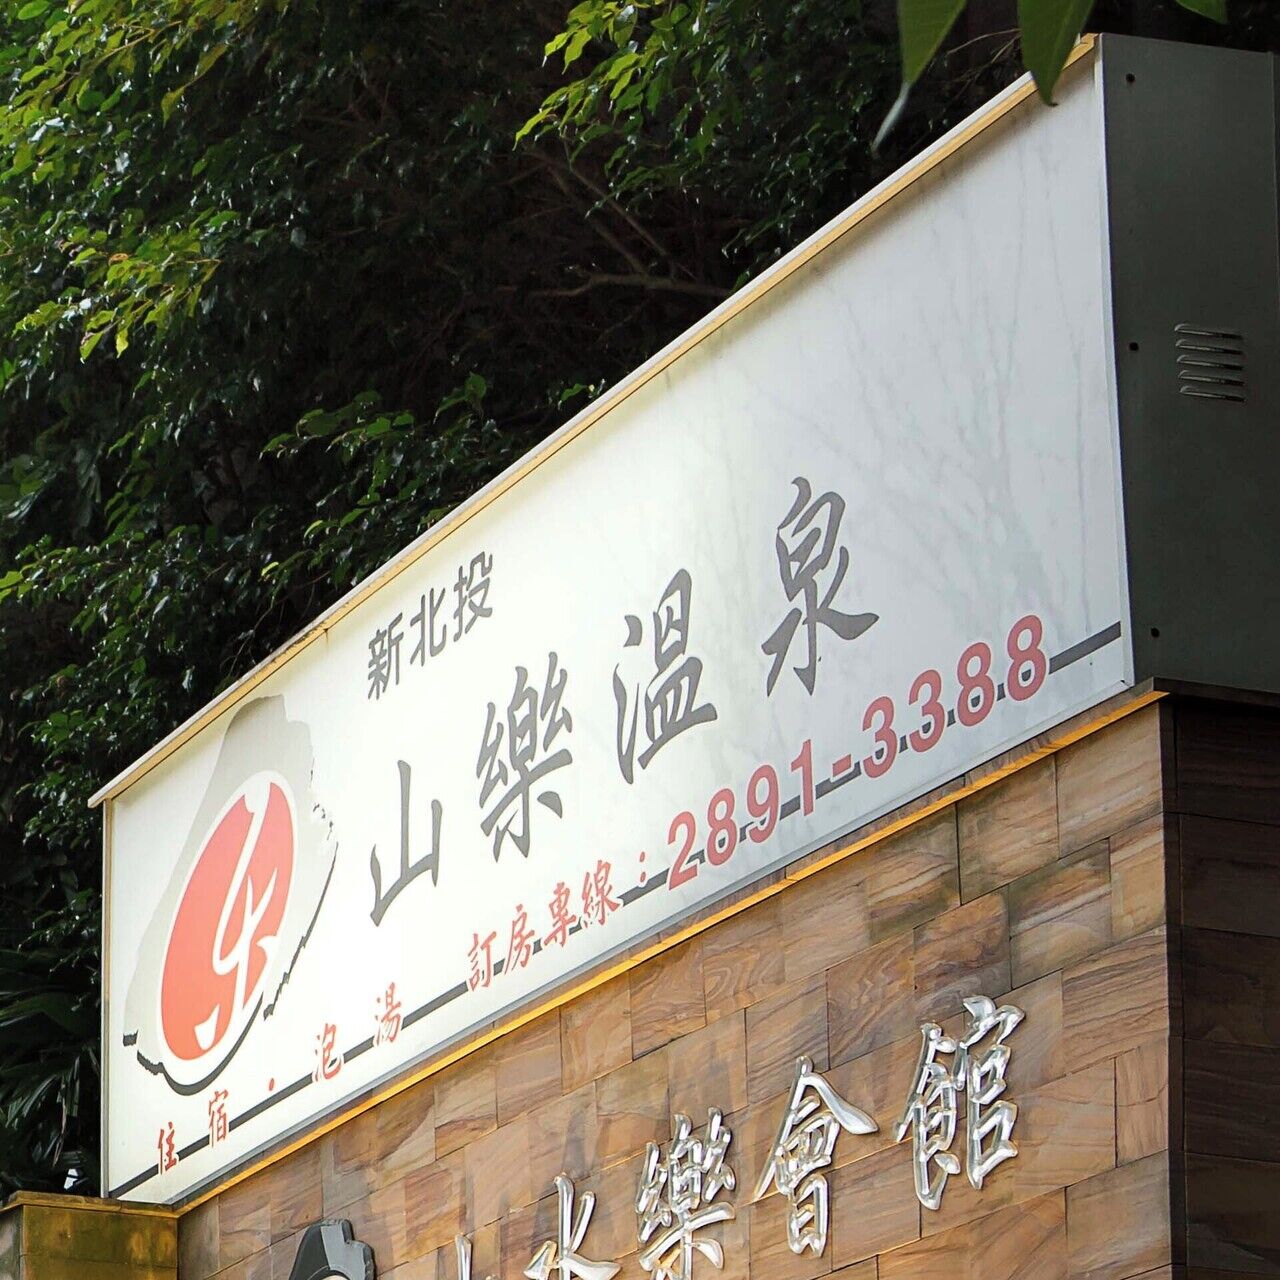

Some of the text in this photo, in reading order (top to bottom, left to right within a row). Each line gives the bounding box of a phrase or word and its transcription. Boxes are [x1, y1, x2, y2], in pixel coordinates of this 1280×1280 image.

[368, 551, 493, 700] 新北投
[370, 476, 879, 927] 山樂溫泉
[667, 615, 1047, 891] 2891-3388
